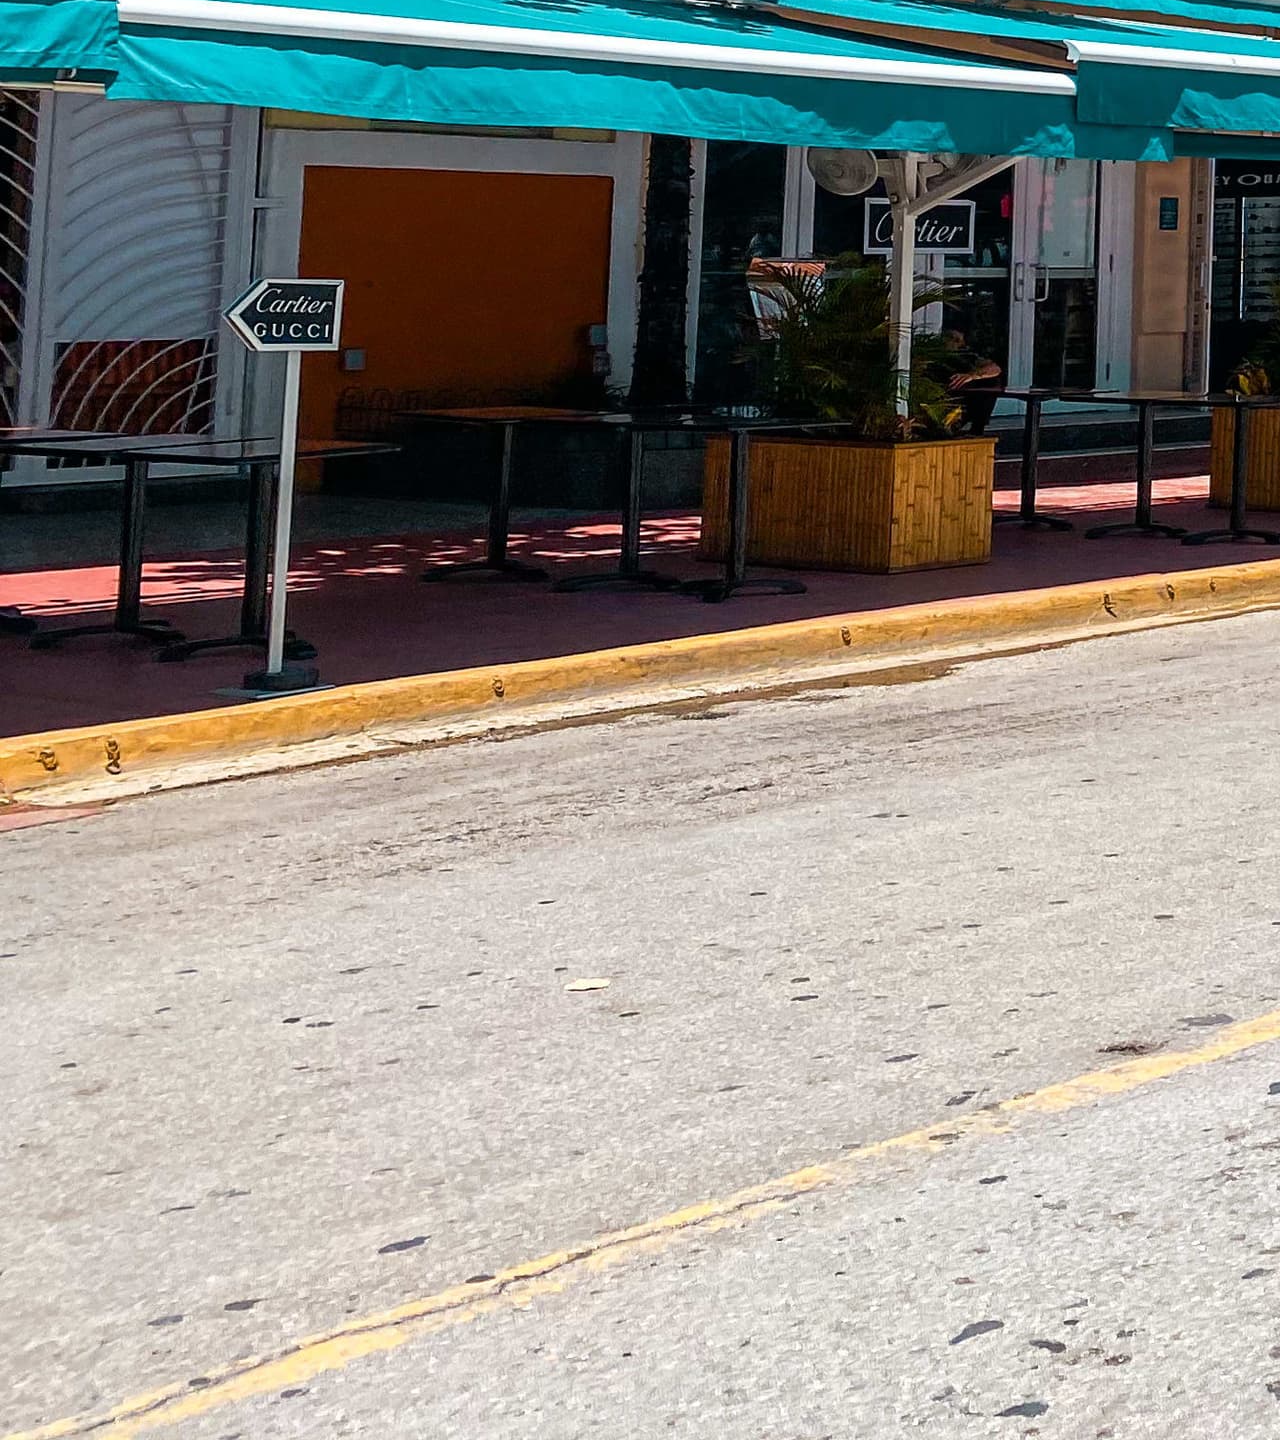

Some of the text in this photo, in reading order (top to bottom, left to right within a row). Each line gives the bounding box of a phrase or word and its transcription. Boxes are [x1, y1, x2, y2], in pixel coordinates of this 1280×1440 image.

[875, 211, 964, 243] Ctier
[256, 288, 333, 313] Cartier
[253, 322, 330, 338] GUCCI
